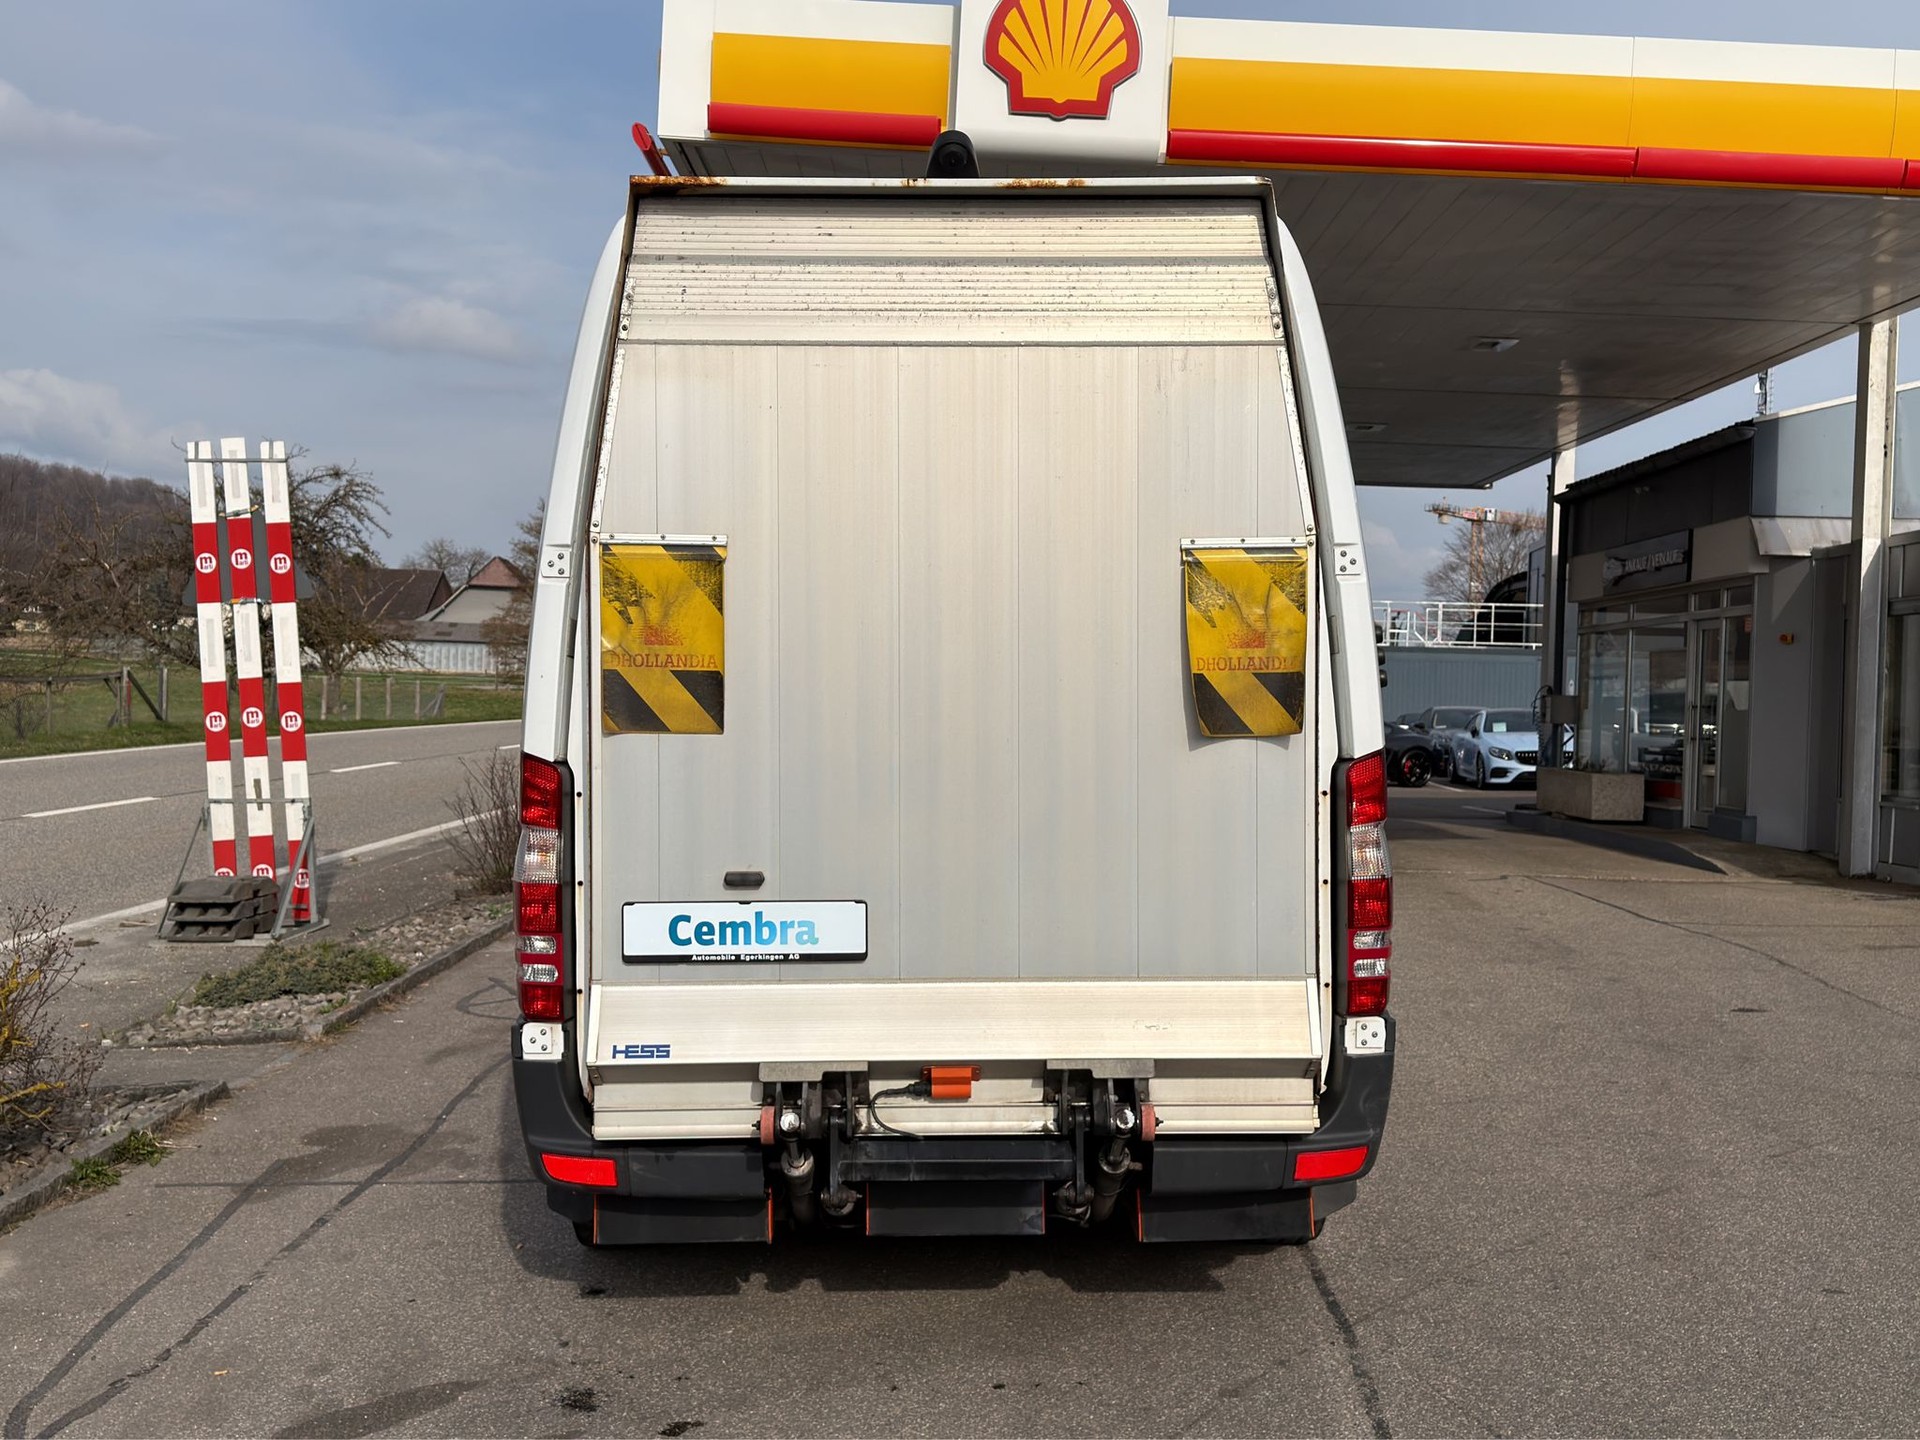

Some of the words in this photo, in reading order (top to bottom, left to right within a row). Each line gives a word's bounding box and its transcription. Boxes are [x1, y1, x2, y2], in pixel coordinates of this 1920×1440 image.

[610, 653, 718, 668] DHOLLANDIA
[668, 911, 819, 946] Cembra
[692, 954, 736, 962] Automobile
[740, 953, 784, 963] Egerkingen
[788, 953, 800, 961] AG
[612, 1044, 671, 1060] HESS
